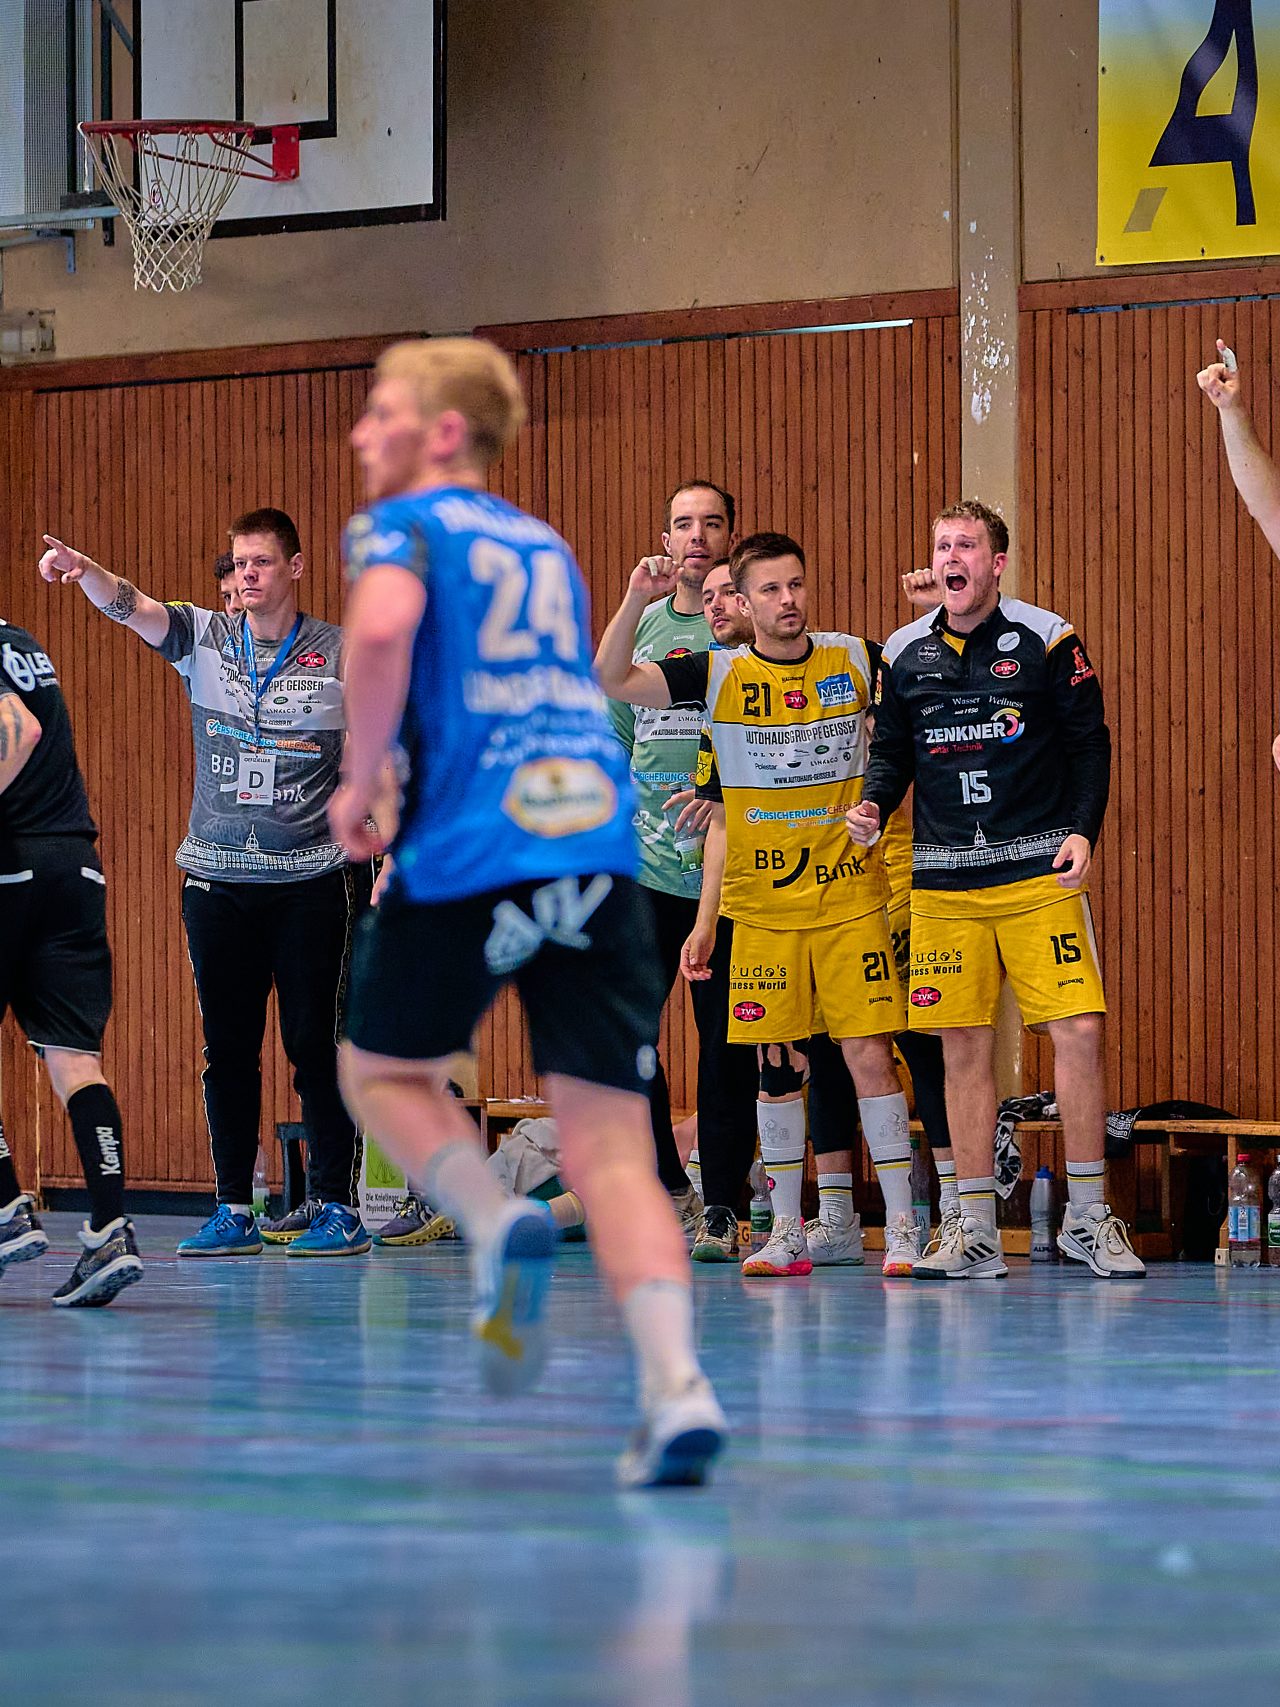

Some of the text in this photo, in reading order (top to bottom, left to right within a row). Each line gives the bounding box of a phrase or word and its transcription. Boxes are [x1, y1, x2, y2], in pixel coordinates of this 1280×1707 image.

[468, 535, 579, 663] 24
[305, 656, 319, 664] TVK
[286, 679, 324, 692] GEISSER
[742, 682, 772, 717] 21
[989, 695, 1024, 709] Wellness
[824, 719, 857, 739] GEISSER
[924, 722, 1006, 744] ZENKNER
[211, 753, 235, 776] BB
[249, 771, 264, 789] D
[959, 769, 992, 805] 15
[273, 784, 307, 802] ank
[755, 849, 786, 870] BB
[1050, 932, 1082, 965] 15
[862, 950, 891, 983] 21
[933, 964, 963, 975] World
[758, 980, 787, 990] World
[917, 993, 933, 1001] TVK
[741, 1008, 757, 1016] TVK
[95, 1126, 121, 1176] Kempa
[365, 1193, 374, 1202] Die
